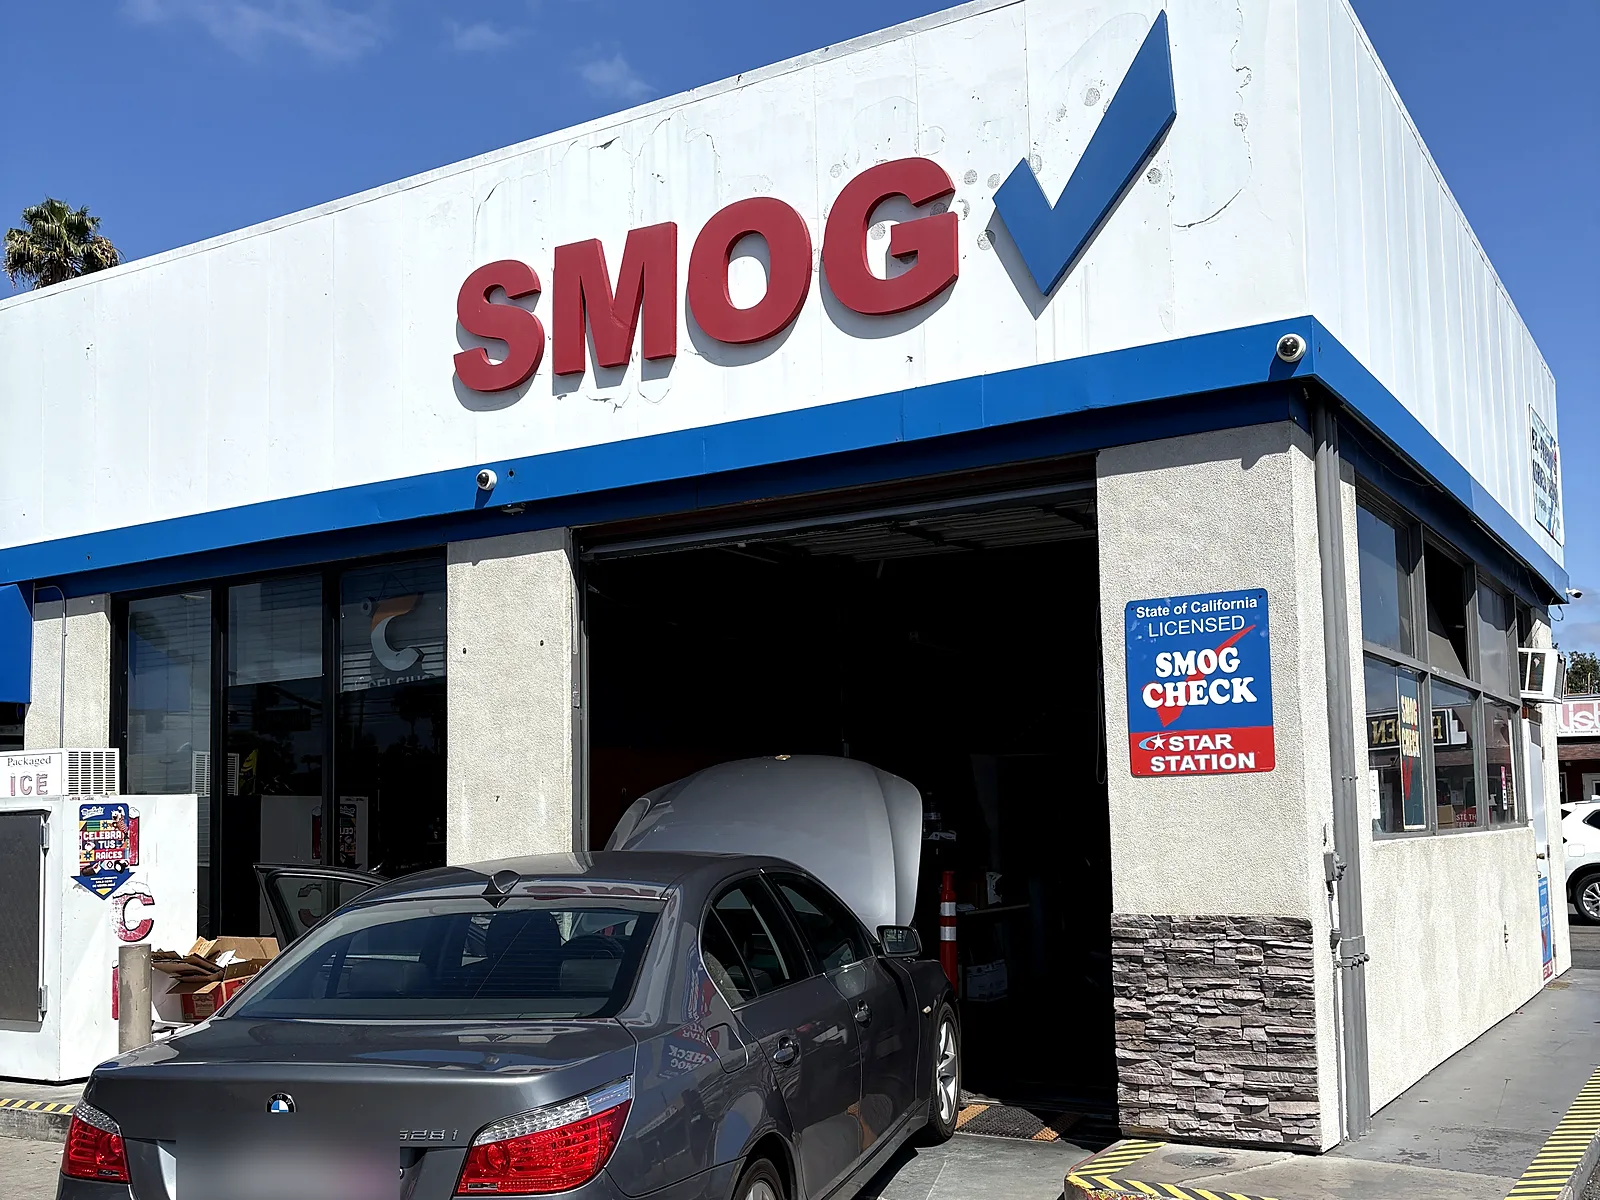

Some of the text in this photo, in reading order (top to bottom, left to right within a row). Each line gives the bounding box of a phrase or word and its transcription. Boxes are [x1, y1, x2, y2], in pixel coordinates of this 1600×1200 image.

[453, 156, 959, 393] SMOG
[1136, 597, 1258, 618] State of California
[1148, 615, 1245, 637] LICENSED
[1155, 647, 1241, 678] SMOG
[1142, 676, 1258, 708] CHECK
[1168, 733, 1234, 752] STAR
[7, 755, 51, 767] Packaged
[1150, 752, 1256, 772] STATION
[10, 771, 48, 796] ICE
[83, 831, 122, 841] CELEBRA
[98, 840, 116, 849] TUS
[96, 849, 123, 860] RAÍCES
